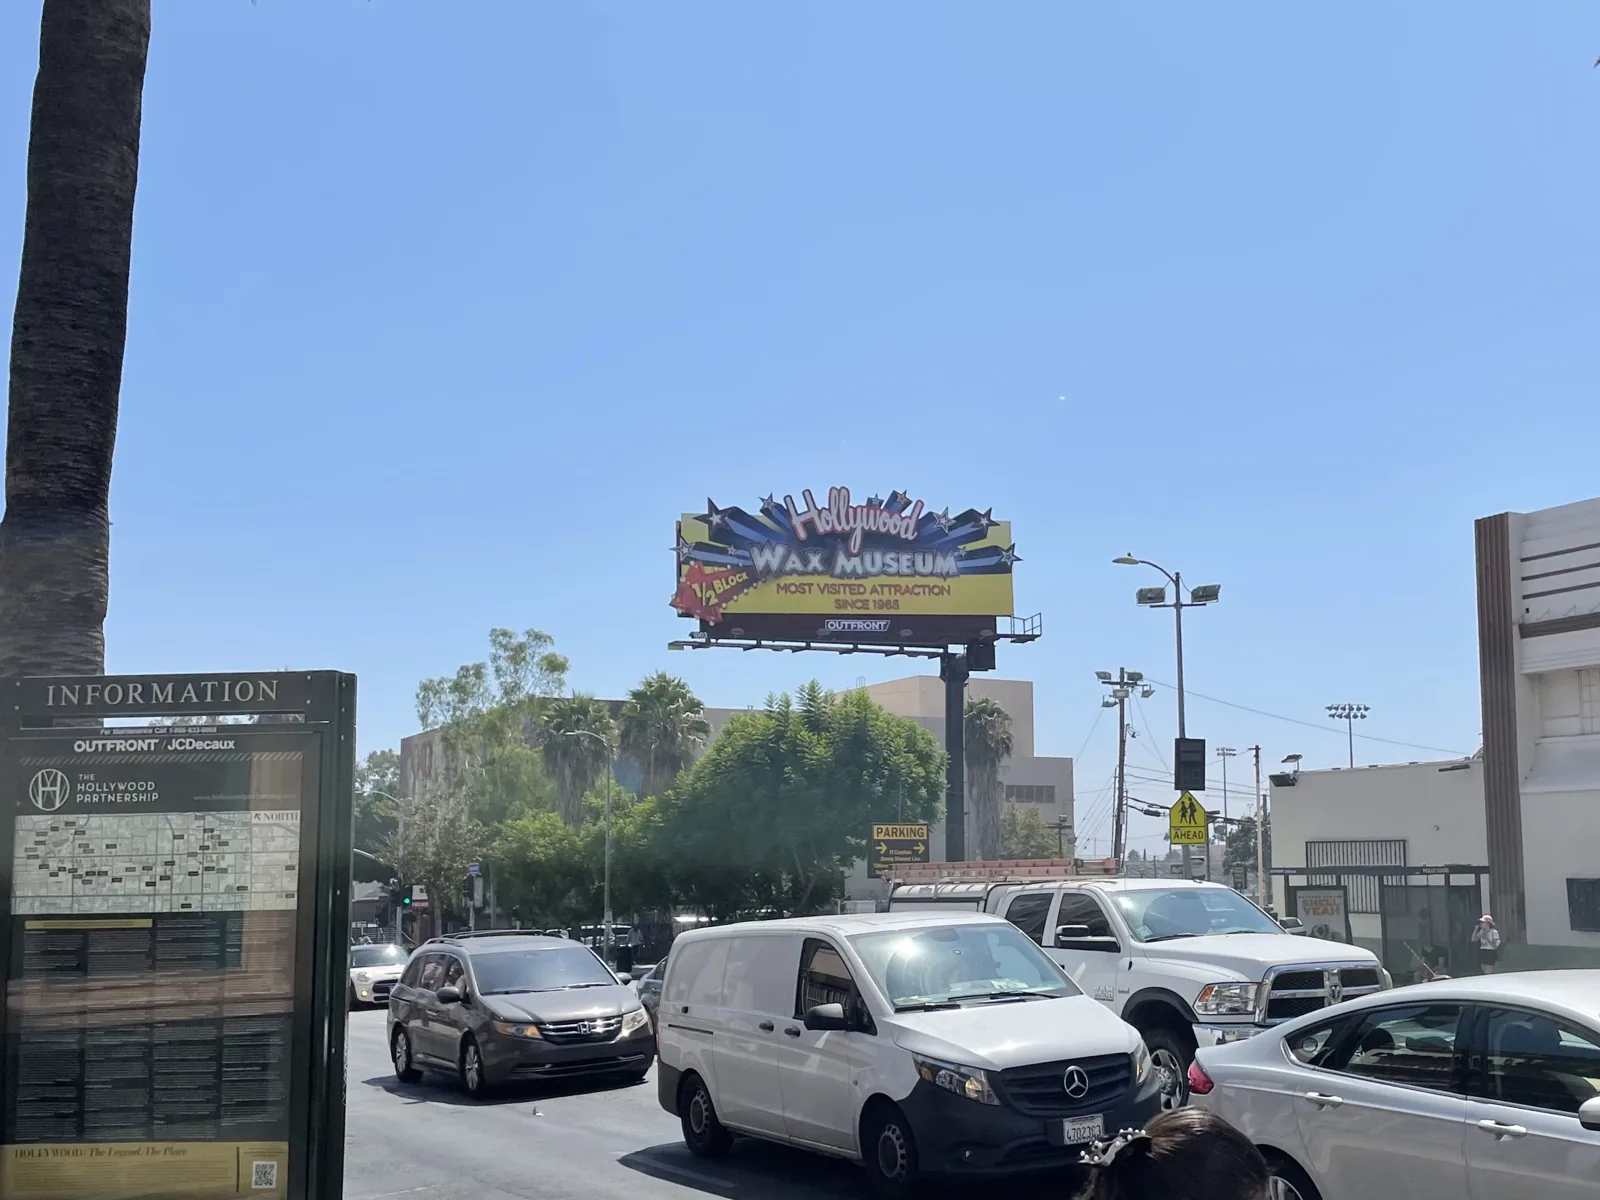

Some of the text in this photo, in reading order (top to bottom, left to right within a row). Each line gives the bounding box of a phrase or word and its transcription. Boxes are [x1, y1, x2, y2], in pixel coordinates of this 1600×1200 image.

[784, 486, 925, 555] Hollywood
[832, 544, 960, 578] MUSEUM
[712, 571, 749, 595] BLOCK
[776, 583, 951, 597] MOST VISITED ATTRACTION
[834, 599, 870, 611] SINCE
[827, 621, 887, 630] OUTFRONT
[46, 680, 280, 707] INFORMATION
[74, 739, 160, 752] OUTFRONT
[167, 738, 236, 750] JCDecaux
[78, 773, 96, 781] THE
[76, 781, 156, 792] HOLLYWOOD
[76, 792, 160, 803] PARTNERSHIP
[263, 813, 299, 821] NORTH
[876, 827, 925, 838] PARKING
[1173, 831, 1204, 840] AHEAD
